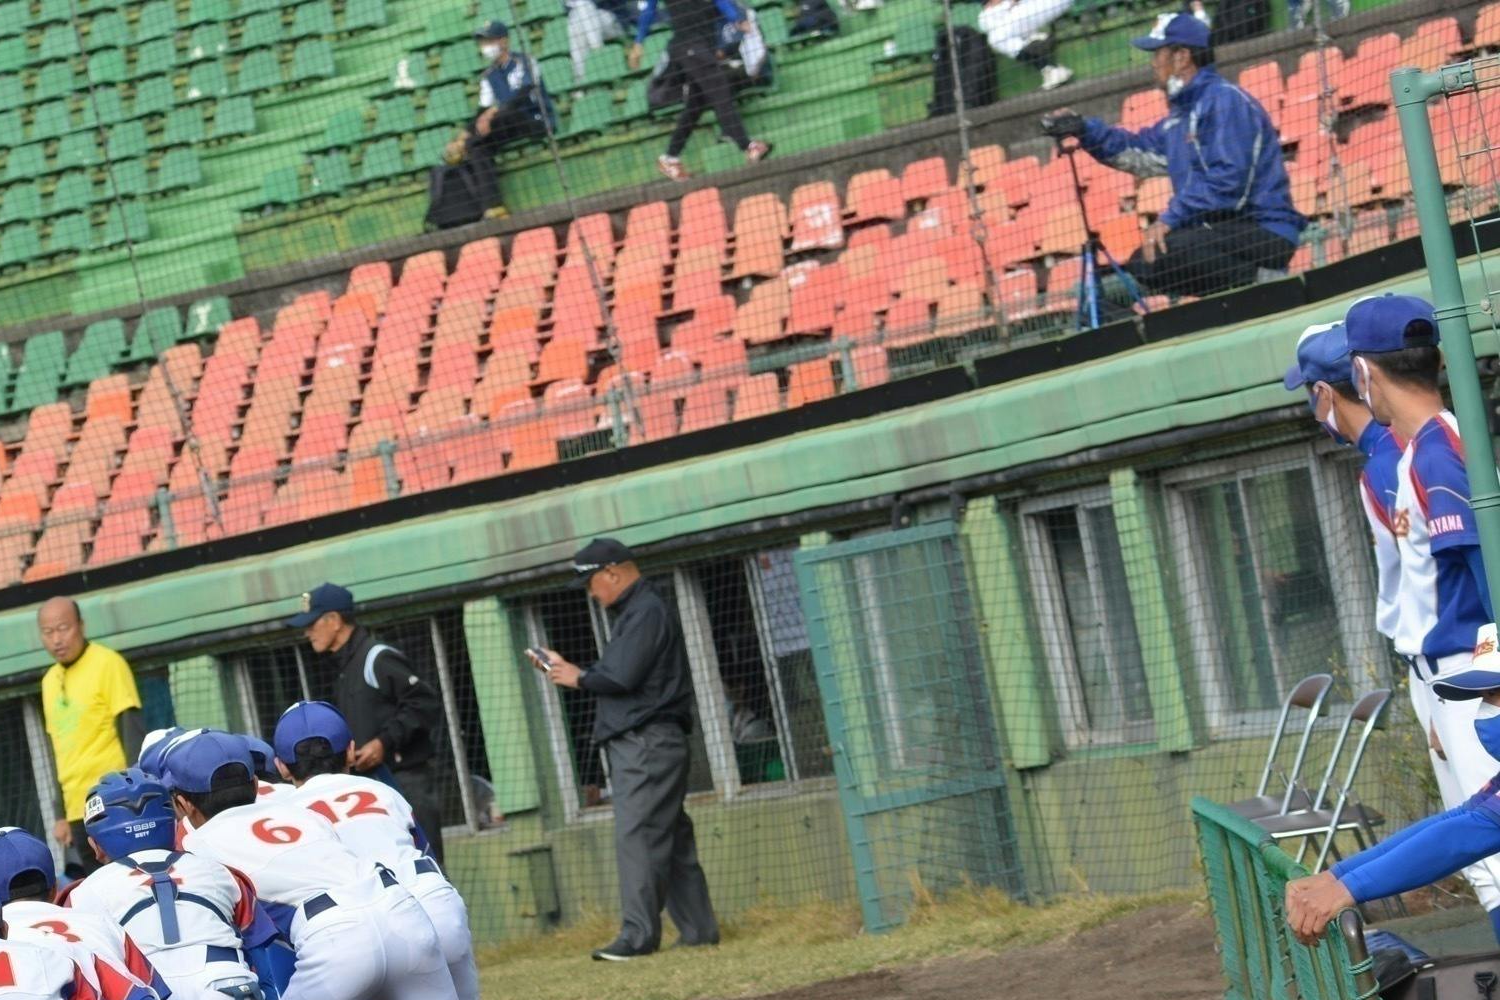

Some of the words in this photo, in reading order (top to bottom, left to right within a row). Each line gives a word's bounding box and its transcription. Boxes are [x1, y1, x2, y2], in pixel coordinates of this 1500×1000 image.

[1428, 514, 1465, 537] AYAMA
[305, 790, 390, 825] 12
[251, 817, 302, 845] 6
